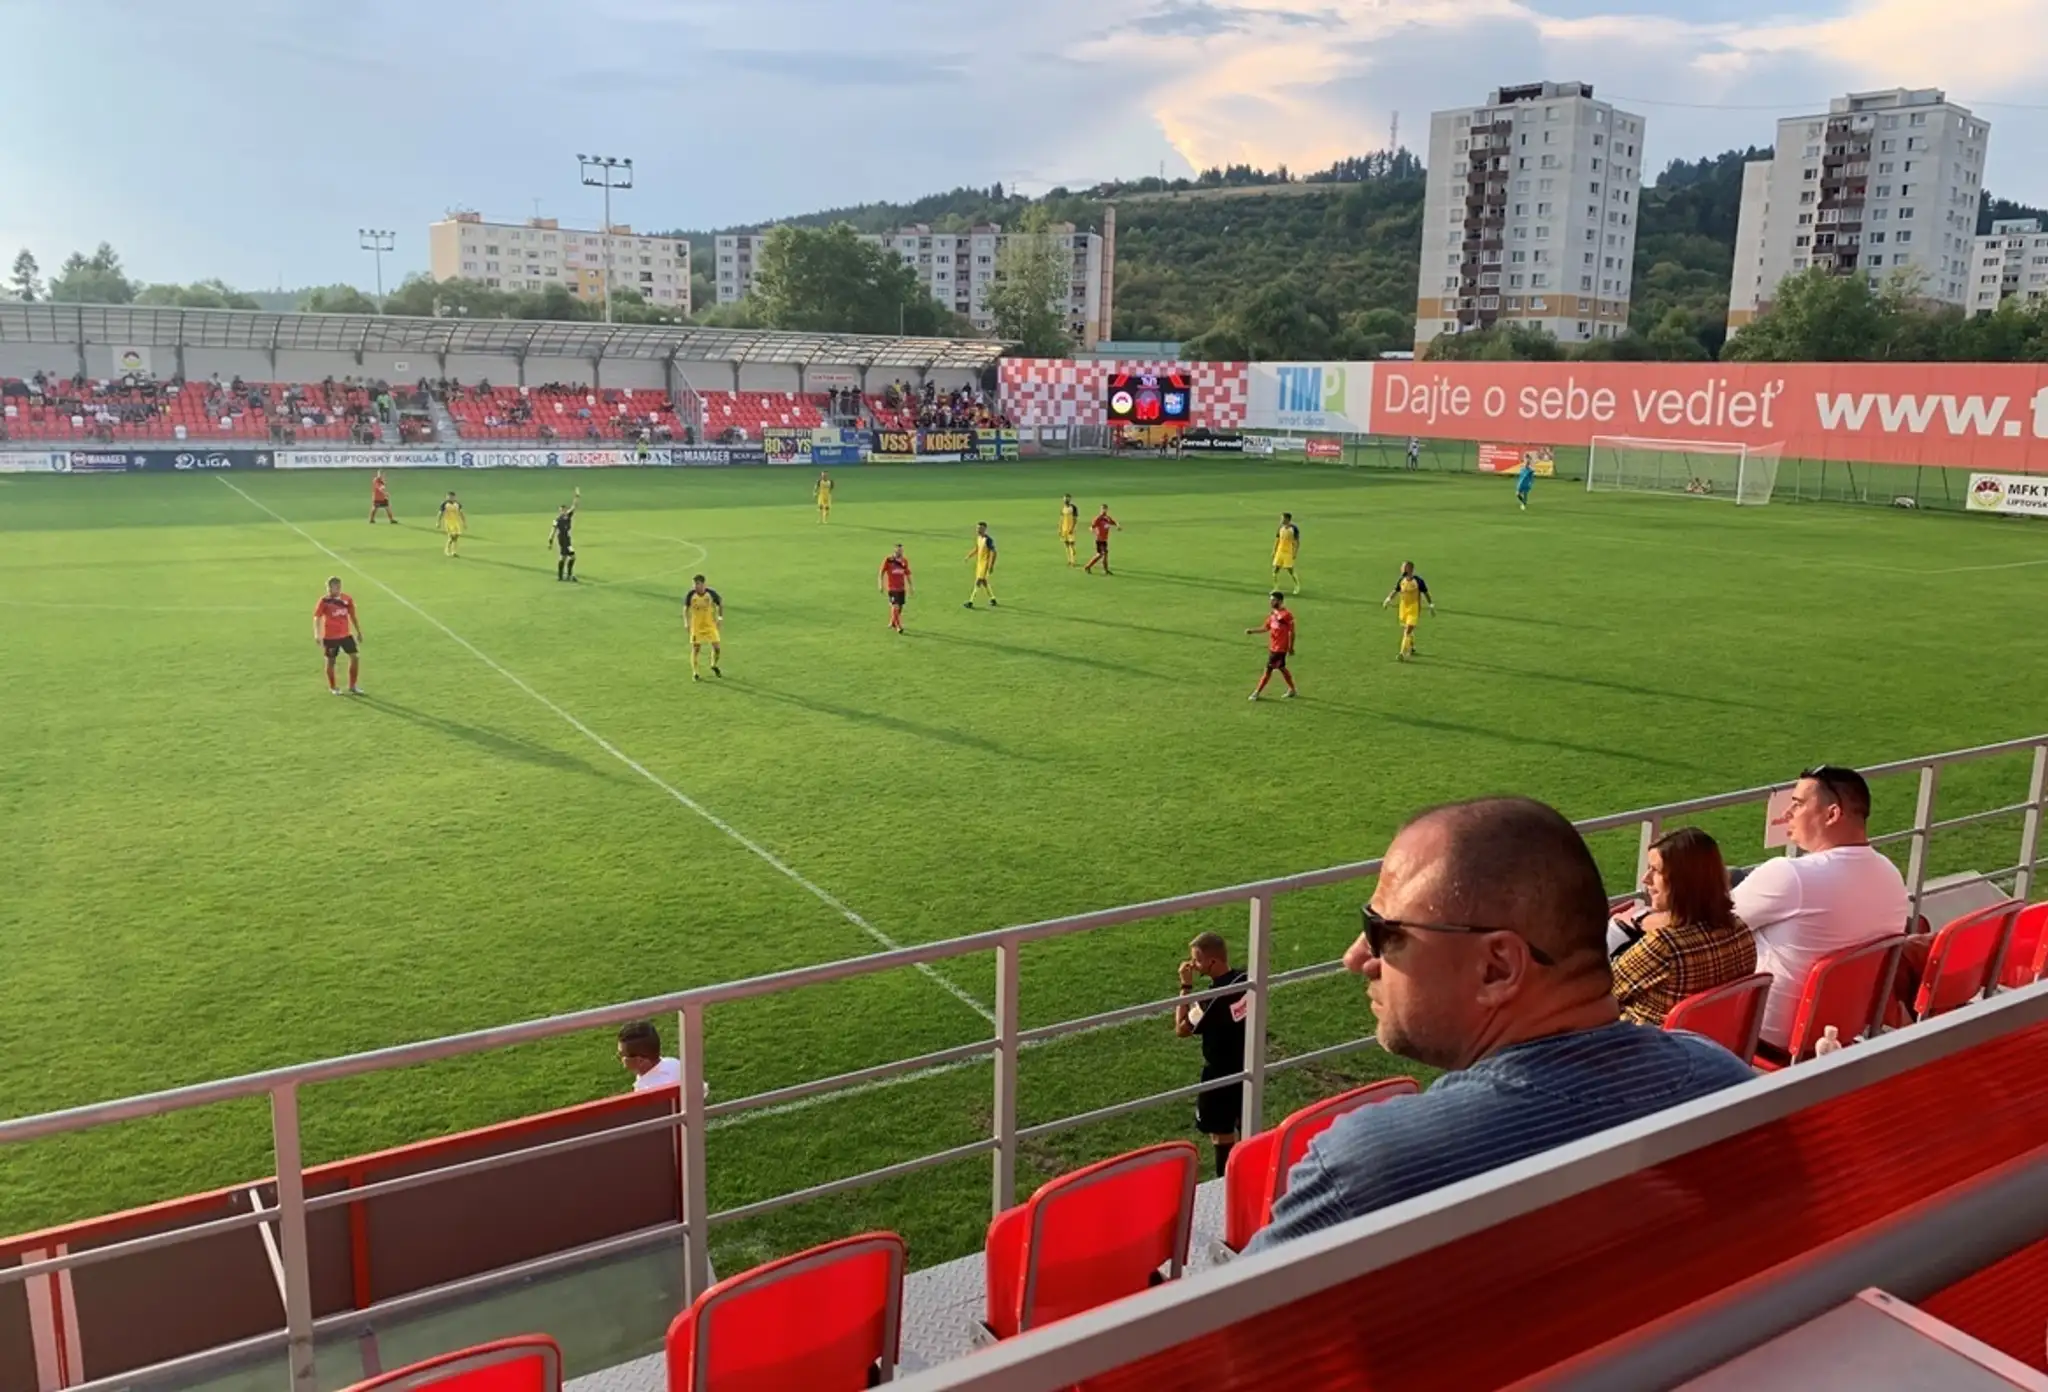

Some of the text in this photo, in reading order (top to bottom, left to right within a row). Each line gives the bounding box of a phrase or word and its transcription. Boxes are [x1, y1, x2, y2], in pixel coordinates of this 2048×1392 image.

[1385, 374, 1785, 428] Dajte o sebe vedieť
[294, 455, 332, 464] MESTO
[684, 451, 730, 461] MANAGER
[196, 458, 231, 467] LIGA
[2007, 484, 2039, 497] MFK
